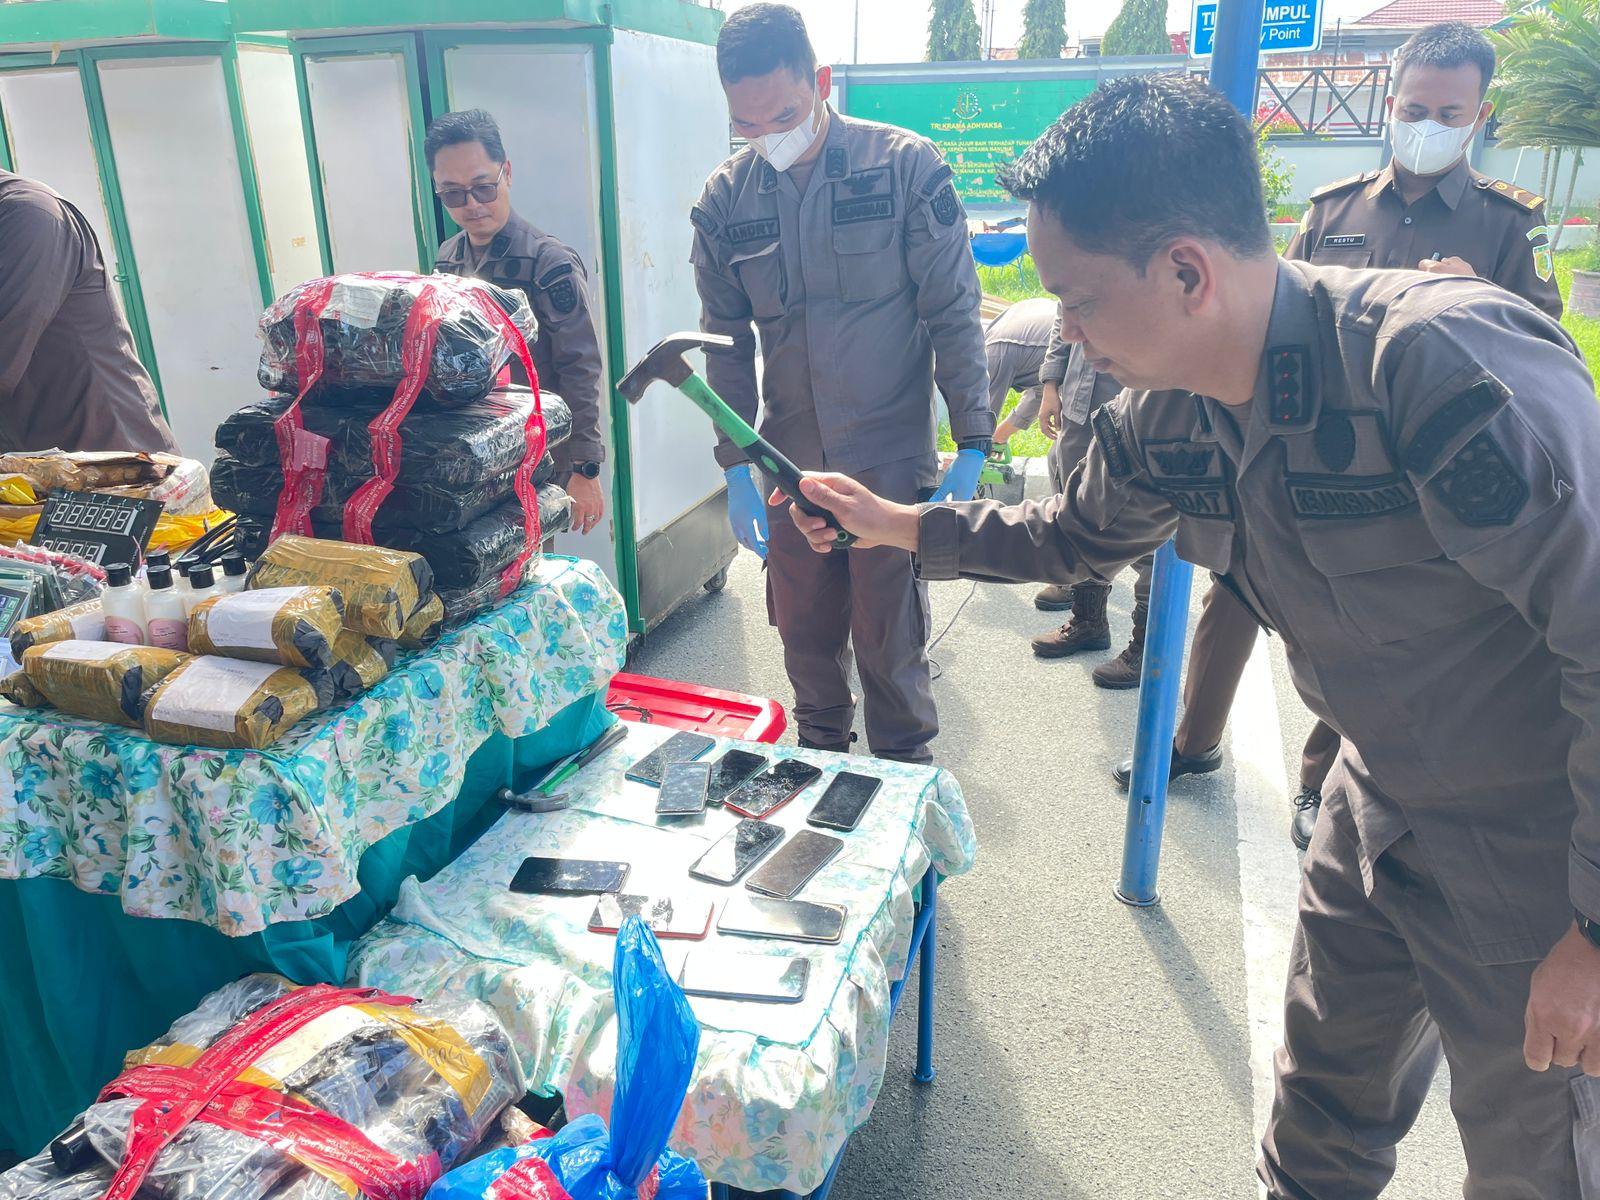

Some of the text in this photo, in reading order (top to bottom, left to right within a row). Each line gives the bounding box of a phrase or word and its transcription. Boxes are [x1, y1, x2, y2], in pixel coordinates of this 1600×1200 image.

[1265, 4, 1311, 21] MPUL
[1269, 27, 1301, 41] Point
[732, 221, 775, 241] ANDRY
